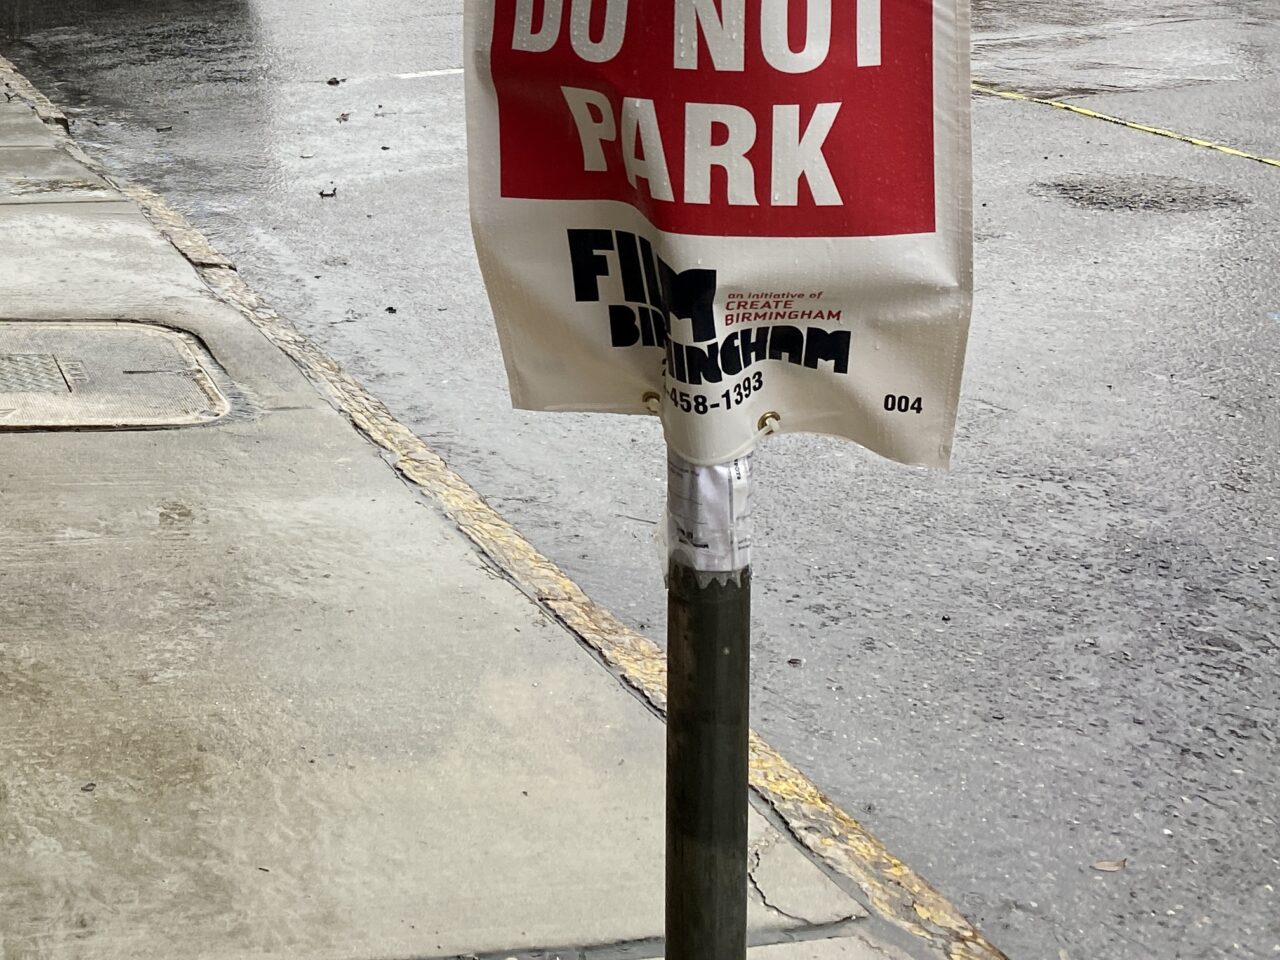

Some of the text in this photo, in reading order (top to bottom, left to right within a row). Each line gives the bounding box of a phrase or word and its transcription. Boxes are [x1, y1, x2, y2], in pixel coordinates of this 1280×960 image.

[559, 85, 844, 207] PARK
[747, 291, 805, 300] initiative
[809, 291, 824, 300] of
[725, 300, 794, 311] CREATE
[725, 310, 842, 327] BIRMINGHAM
[883, 394, 923, 414] 004
